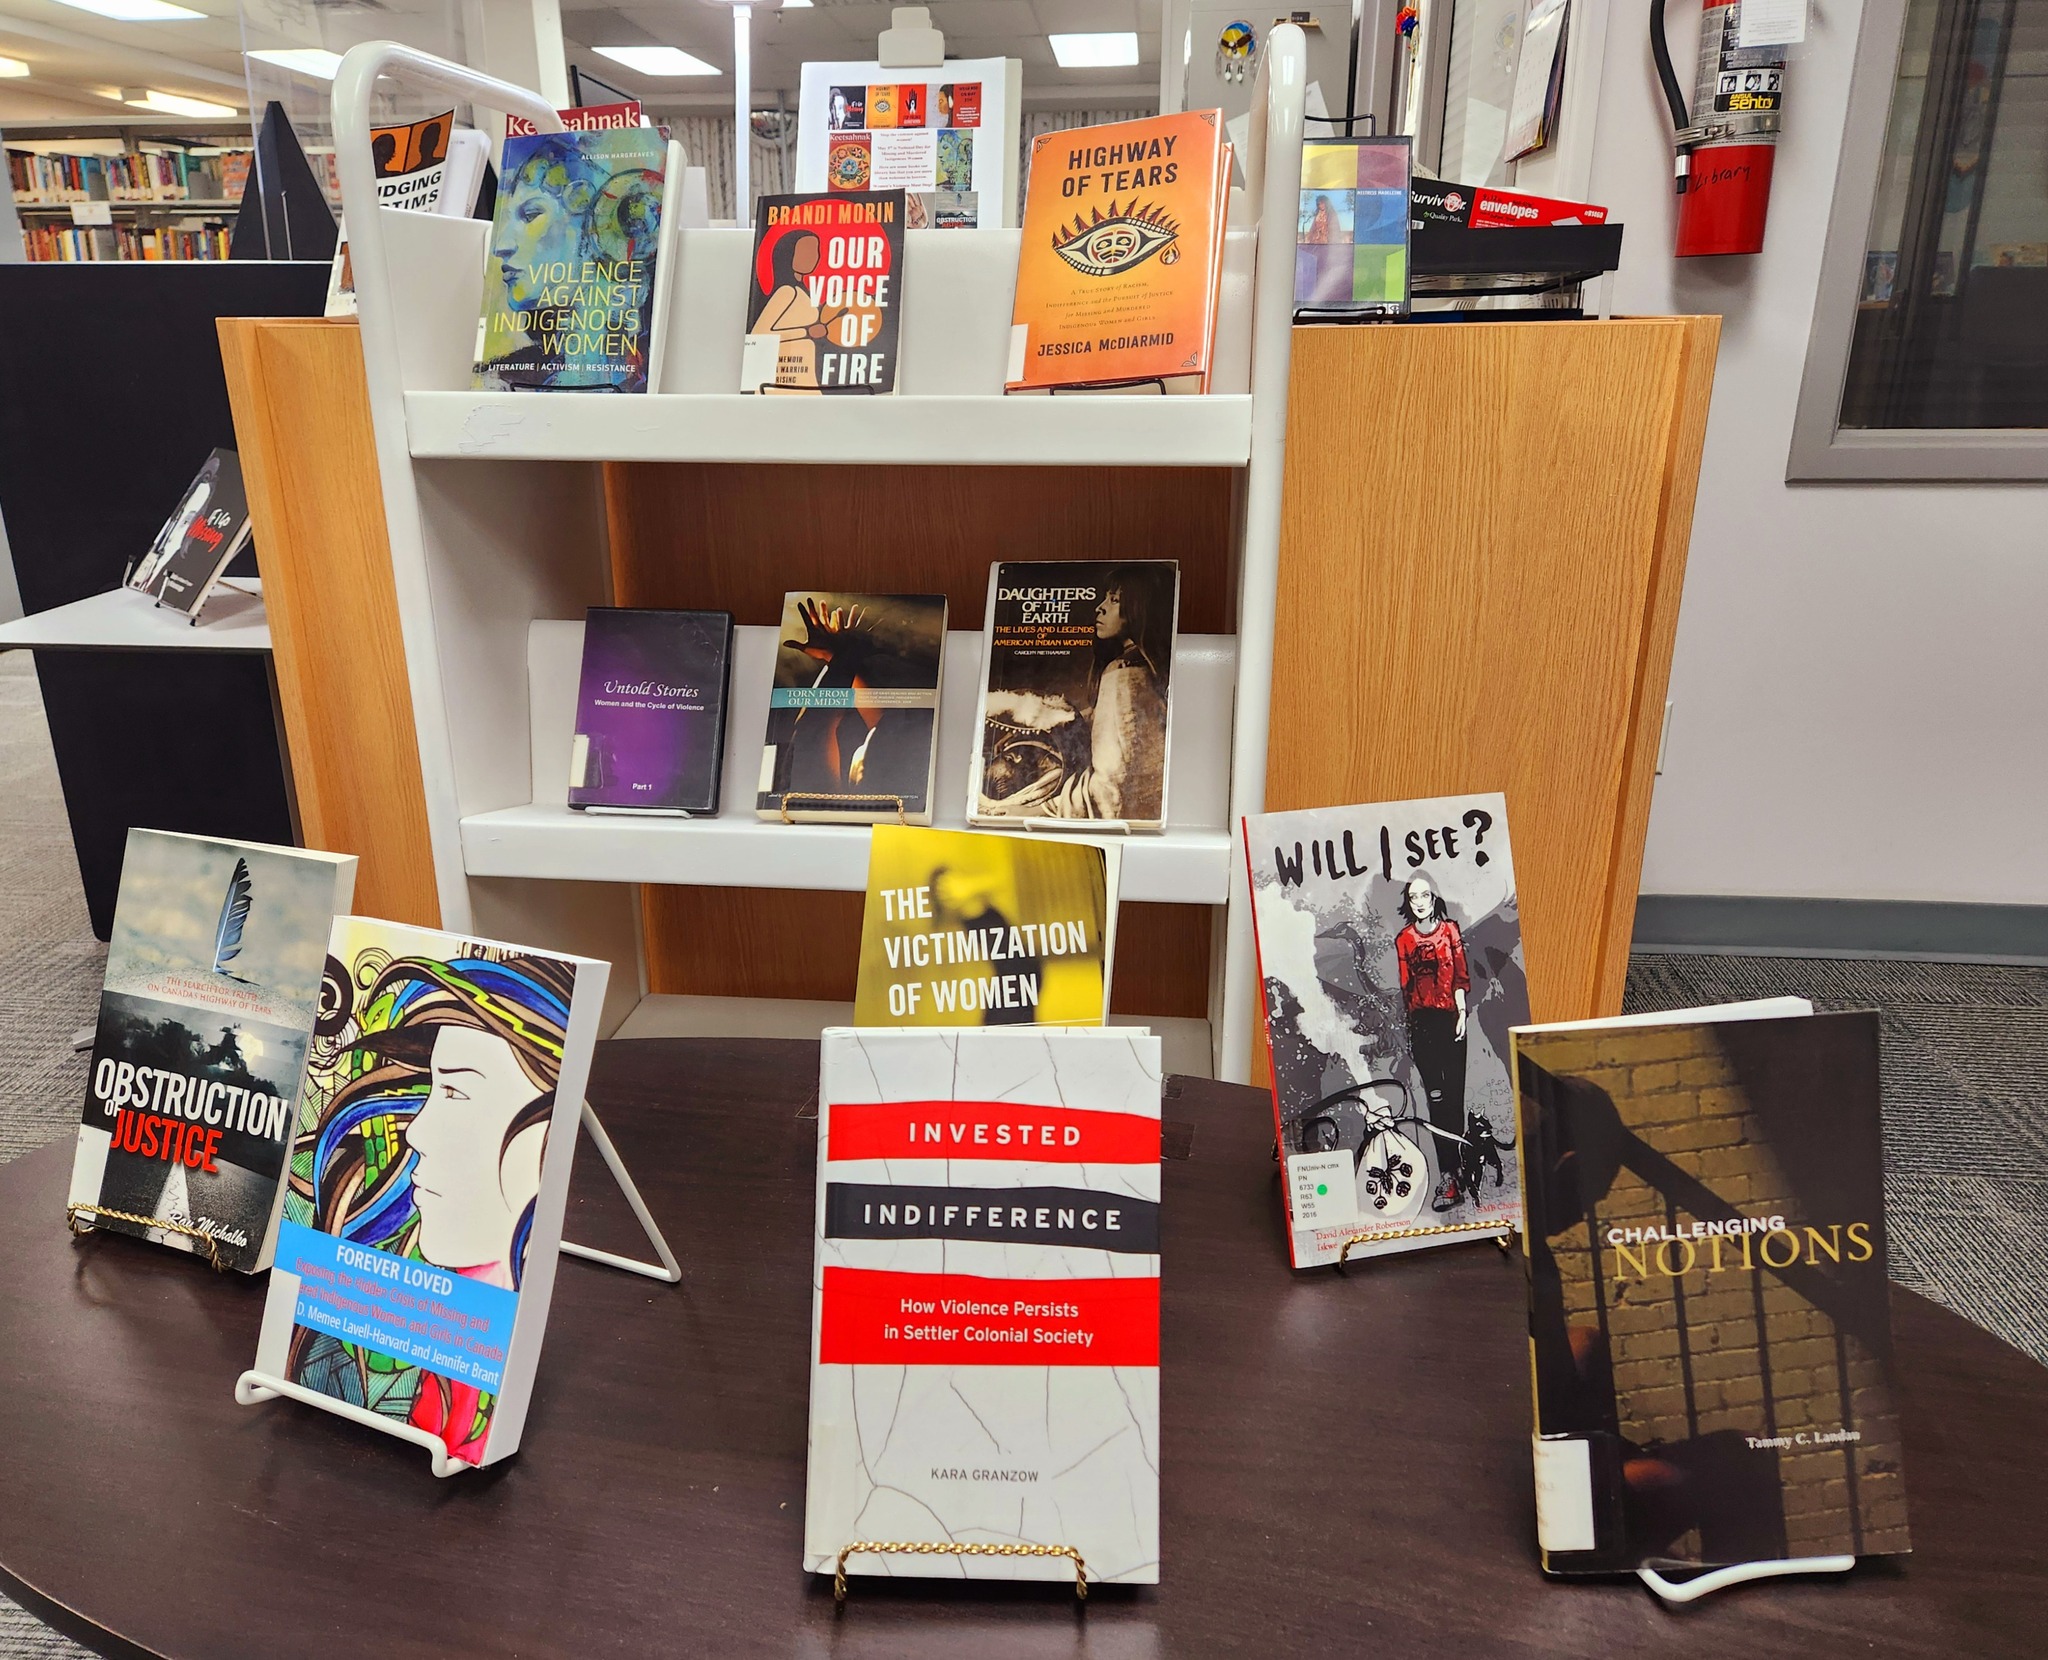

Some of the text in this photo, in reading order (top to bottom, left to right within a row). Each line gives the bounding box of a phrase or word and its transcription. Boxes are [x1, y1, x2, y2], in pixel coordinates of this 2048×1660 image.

[508, 107, 639, 135] Kesahnak
[830, 132, 871, 142] Keetsahnak
[1068, 135, 1177, 170] HIGHWAY
[1062, 163, 1178, 197] OF TEARS
[1694, 164, 1752, 192] Library
[767, 204, 832, 226] BRANDI
[838, 201, 894, 224] MORIN
[1429, 212, 1449, 222] Quality
[1480, 200, 1539, 219] envelopes
[828, 236, 885, 269] OUR
[528, 261, 644, 284] VIOLENCE
[537, 285, 642, 307] AGAINST
[809, 275, 890, 307] VOICE
[493, 309, 640, 332] INDIGENOUS
[840, 314, 875, 347] OF
[542, 333, 638, 356] WOMEN
[1037, 333, 1174, 356] JESSICA McDIARMID
[488, 363, 636, 372] LITERATURE ACTIVISM RESISTANCE
[821, 353, 885, 385] FIRE
[775, 376, 797, 384] RISING
[998, 587, 1097, 601] DAUGHTERS
[1022, 601, 1071, 612] OF THE
[1022, 612, 1069, 624] EARTH
[995, 626, 1011, 634] THE
[1056, 626, 1095, 634] LEGENDS
[604, 680, 699, 698] Untold Stories
[786, 689, 849, 698] TORN FROM
[594, 699, 620, 707] Women
[647, 702, 666, 710] Cycle
[676, 703, 704, 711] Violence
[788, 698, 849, 706] OUR MIDST
[1275, 809, 1493, 888] WILL I SEE?
[880, 886, 932, 921] THE
[883, 920, 1088, 969] VICTIMIZATION
[147, 983, 159, 992] ON
[200, 994, 237, 1007] HIGHWAY
[240, 1002, 249, 1010] OF
[251, 1003, 272, 1015] TEARS
[166, 976, 181, 986] THE
[183, 979, 212, 992] SEARCH
[232, 989, 258, 1001] TRUTH
[888, 973, 1039, 1016] OF WOMEN
[94, 1058, 289, 1142] OBSTRUCTION
[104, 1100, 122, 1117] OF
[110, 1108, 224, 1174] JUSTICE
[909, 1122, 1080, 1146] INVESTED
[1299, 1183, 1314, 1191] 6733
[864, 1204, 1121, 1230] INDIFFERENCE
[1302, 1211, 1317, 1219] 2016
[198, 1216, 248, 1247] Michalko
[1316, 1219, 1411, 1240] David Alexander Robertson
[1607, 1215, 1786, 1244] CHALLENGING
[1613, 1222, 1873, 1282] NOTIONS
[336, 1245, 453, 1296] FOREVER LOVED
[296, 1257, 489, 1333] Exposing the Hidden Crisis of Missing and
[900, 1298, 1079, 1317] How Violence Persists
[320, 1288, 503, 1361] Indigenous Women and Girls in Canada
[884, 1324, 1094, 1347] in Settler Colonial Society
[297, 1301, 499, 1386] D. Memee Lavell-Harvard and Jennifer Brant
[1745, 1428, 1860, 1450] Tammy C. Landau
[931, 1468, 1039, 1482] KARA GRANZOW
